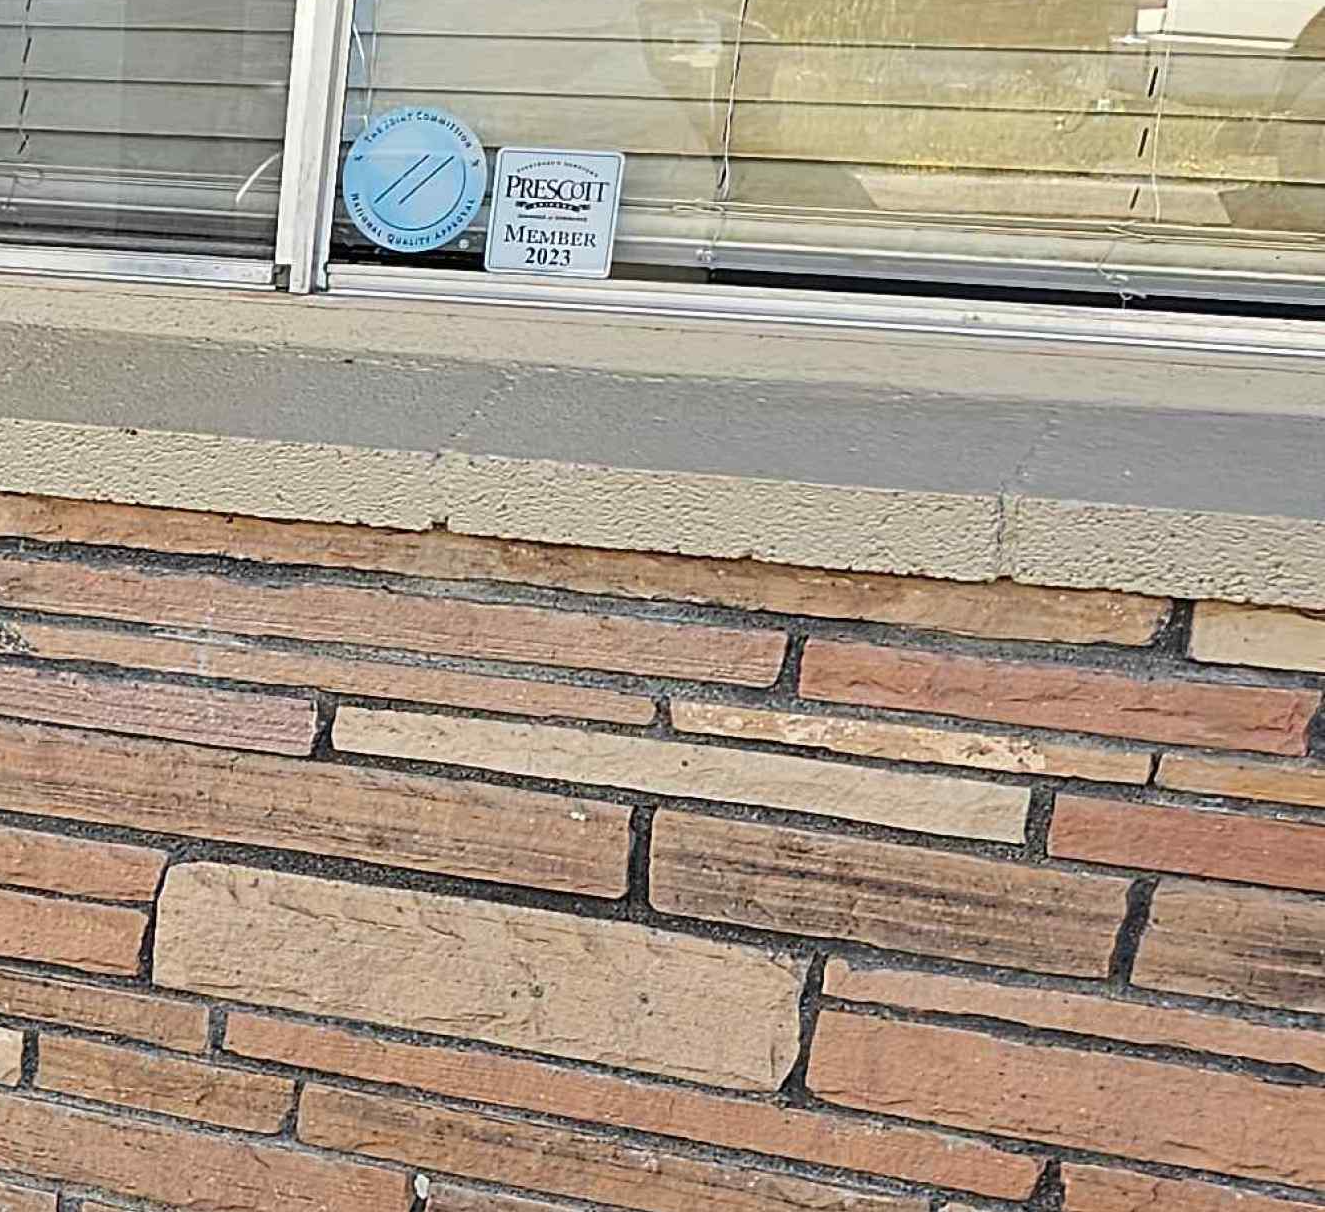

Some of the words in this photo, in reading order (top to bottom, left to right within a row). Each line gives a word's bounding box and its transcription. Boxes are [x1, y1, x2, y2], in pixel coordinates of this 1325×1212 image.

[506, 175, 610, 202] PRESCOTT
[504, 224, 597, 248] MEMBER
[524, 246, 571, 267] 2023
